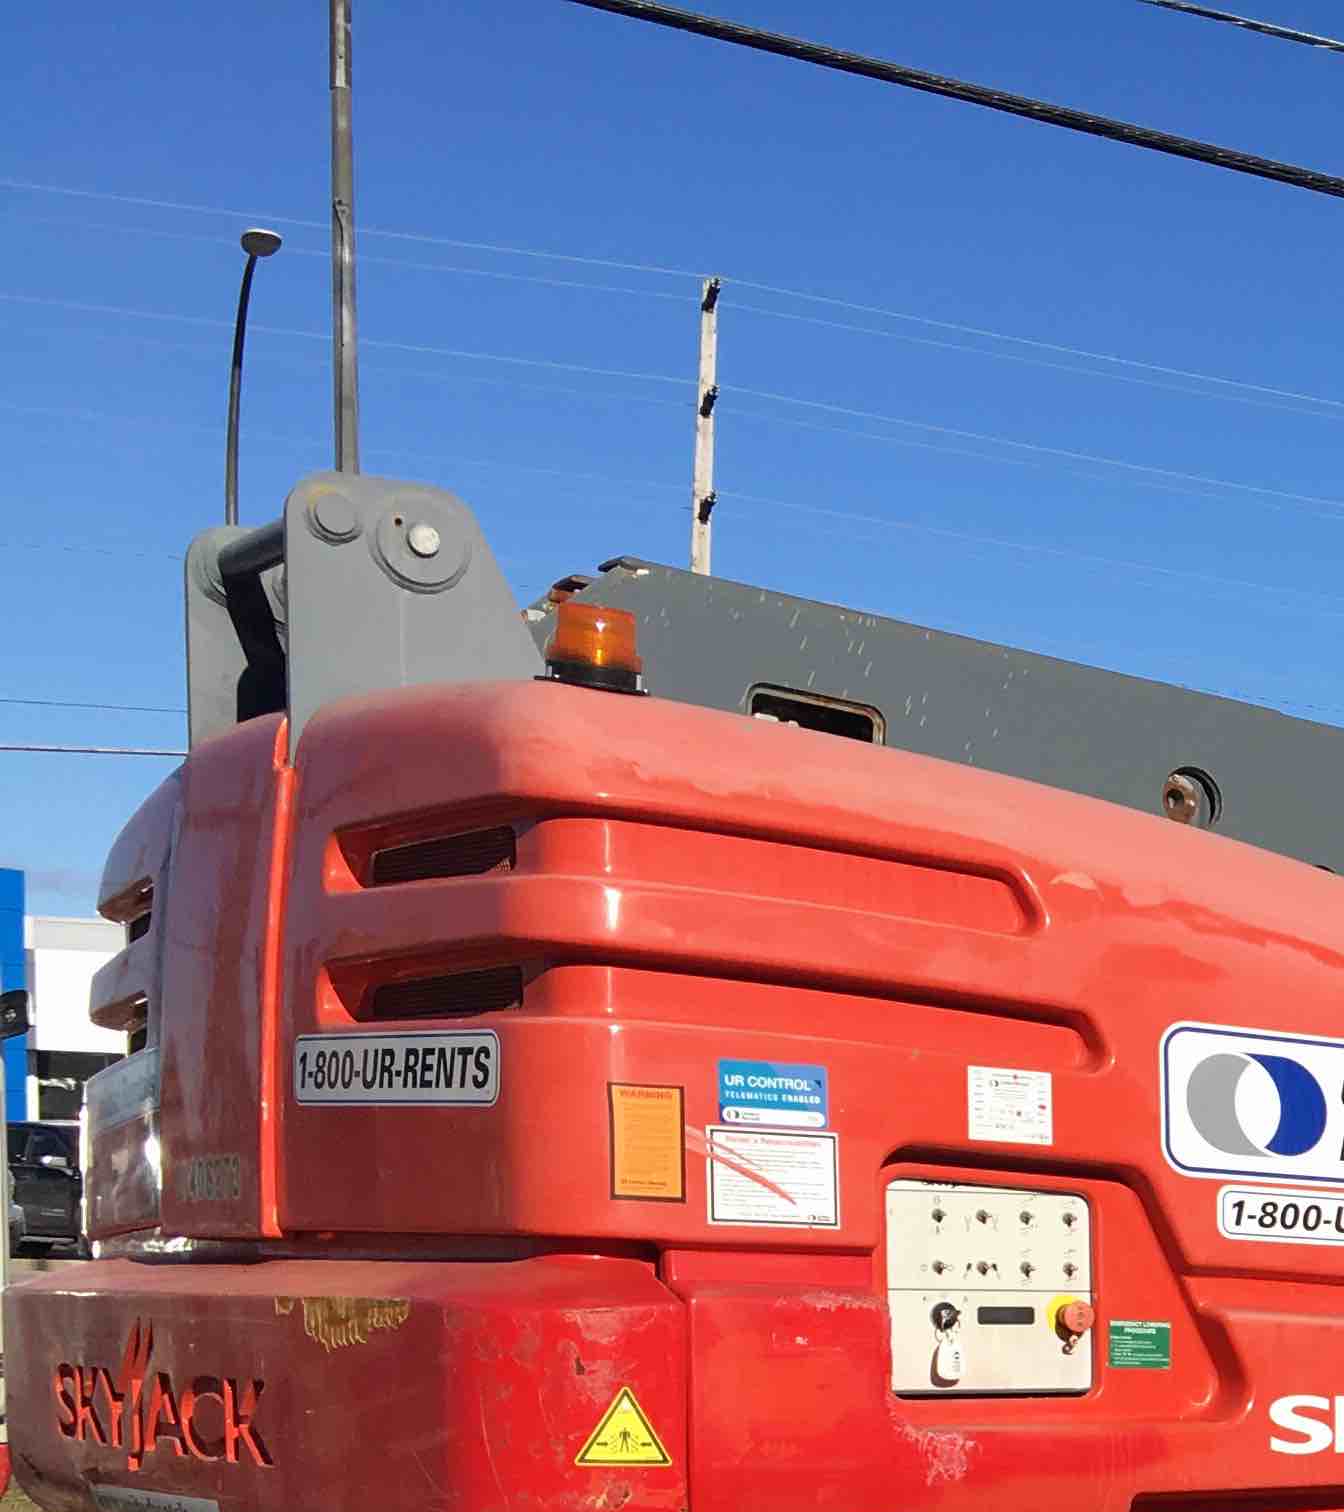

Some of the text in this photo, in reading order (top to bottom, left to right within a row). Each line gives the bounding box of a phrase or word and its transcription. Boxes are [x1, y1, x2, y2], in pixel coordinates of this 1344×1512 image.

[298, 1045, 490, 1090] 1-800-UR-RENTS
[724, 1074, 812, 1092] UR CONTROL
[54, 1316, 276, 1472] SKYJACK
